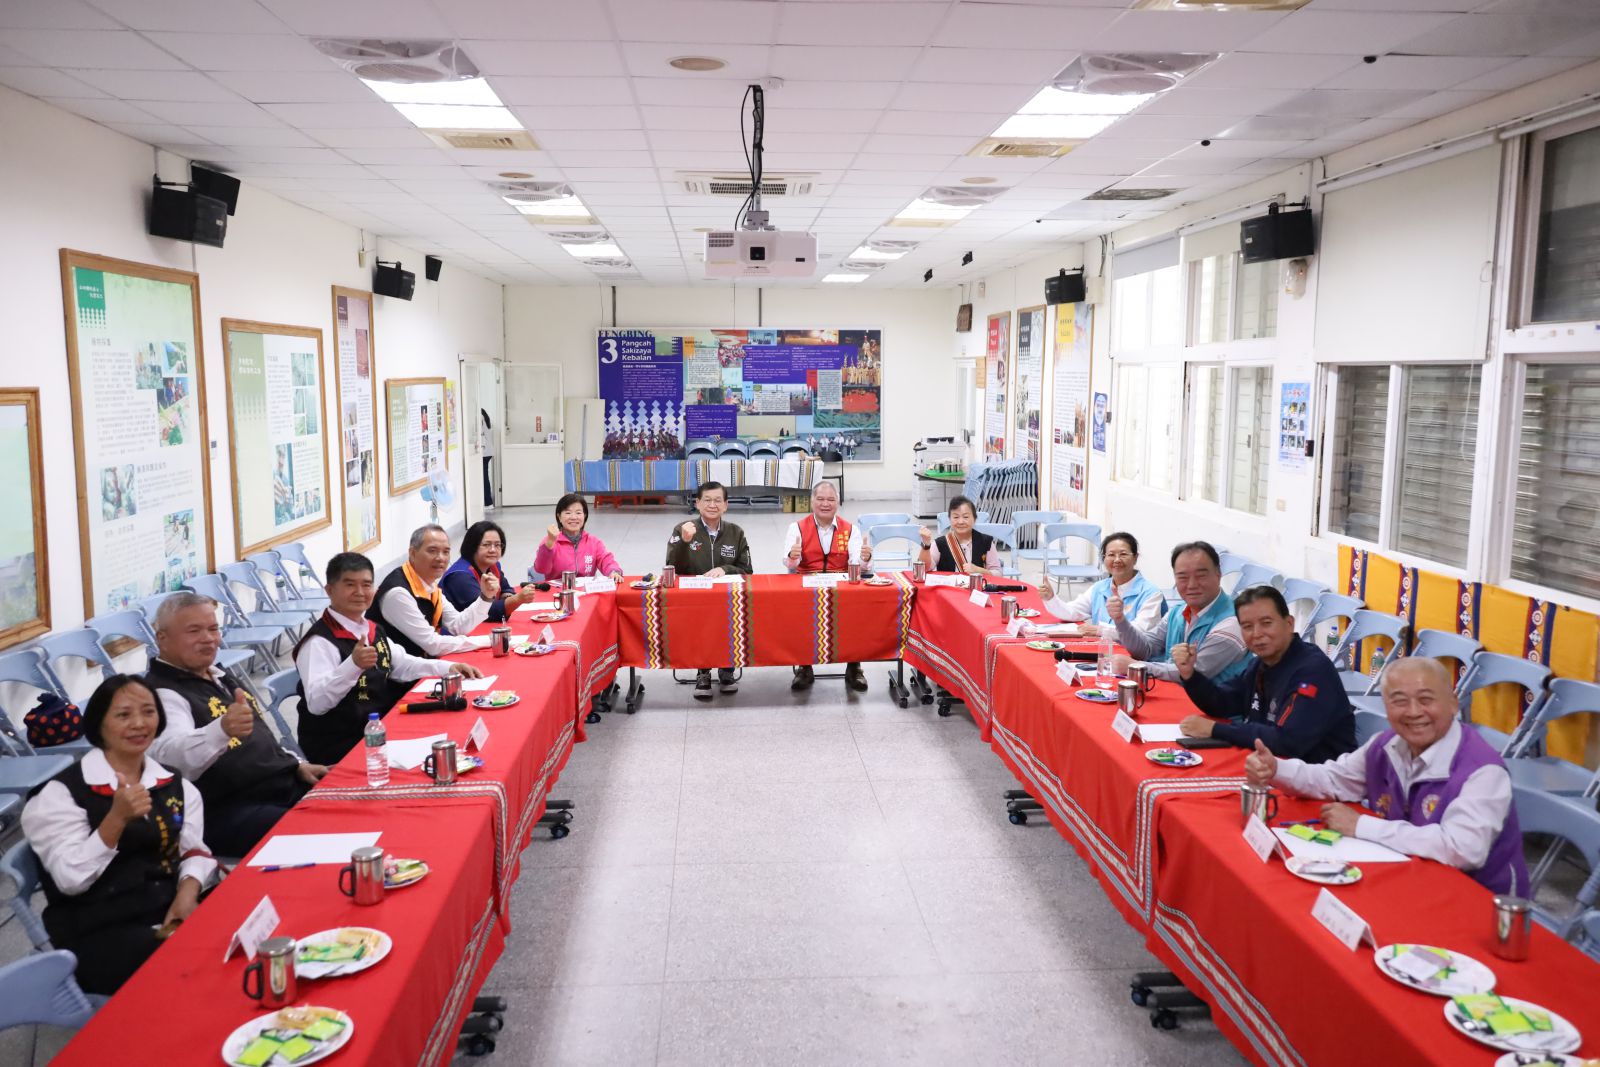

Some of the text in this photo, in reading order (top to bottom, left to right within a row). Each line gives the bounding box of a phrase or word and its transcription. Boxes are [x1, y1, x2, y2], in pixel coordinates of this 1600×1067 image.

[622, 340, 651, 348] Pangcah
[601, 339, 618, 363] 3
[622, 347, 651, 355] Sakizaya
